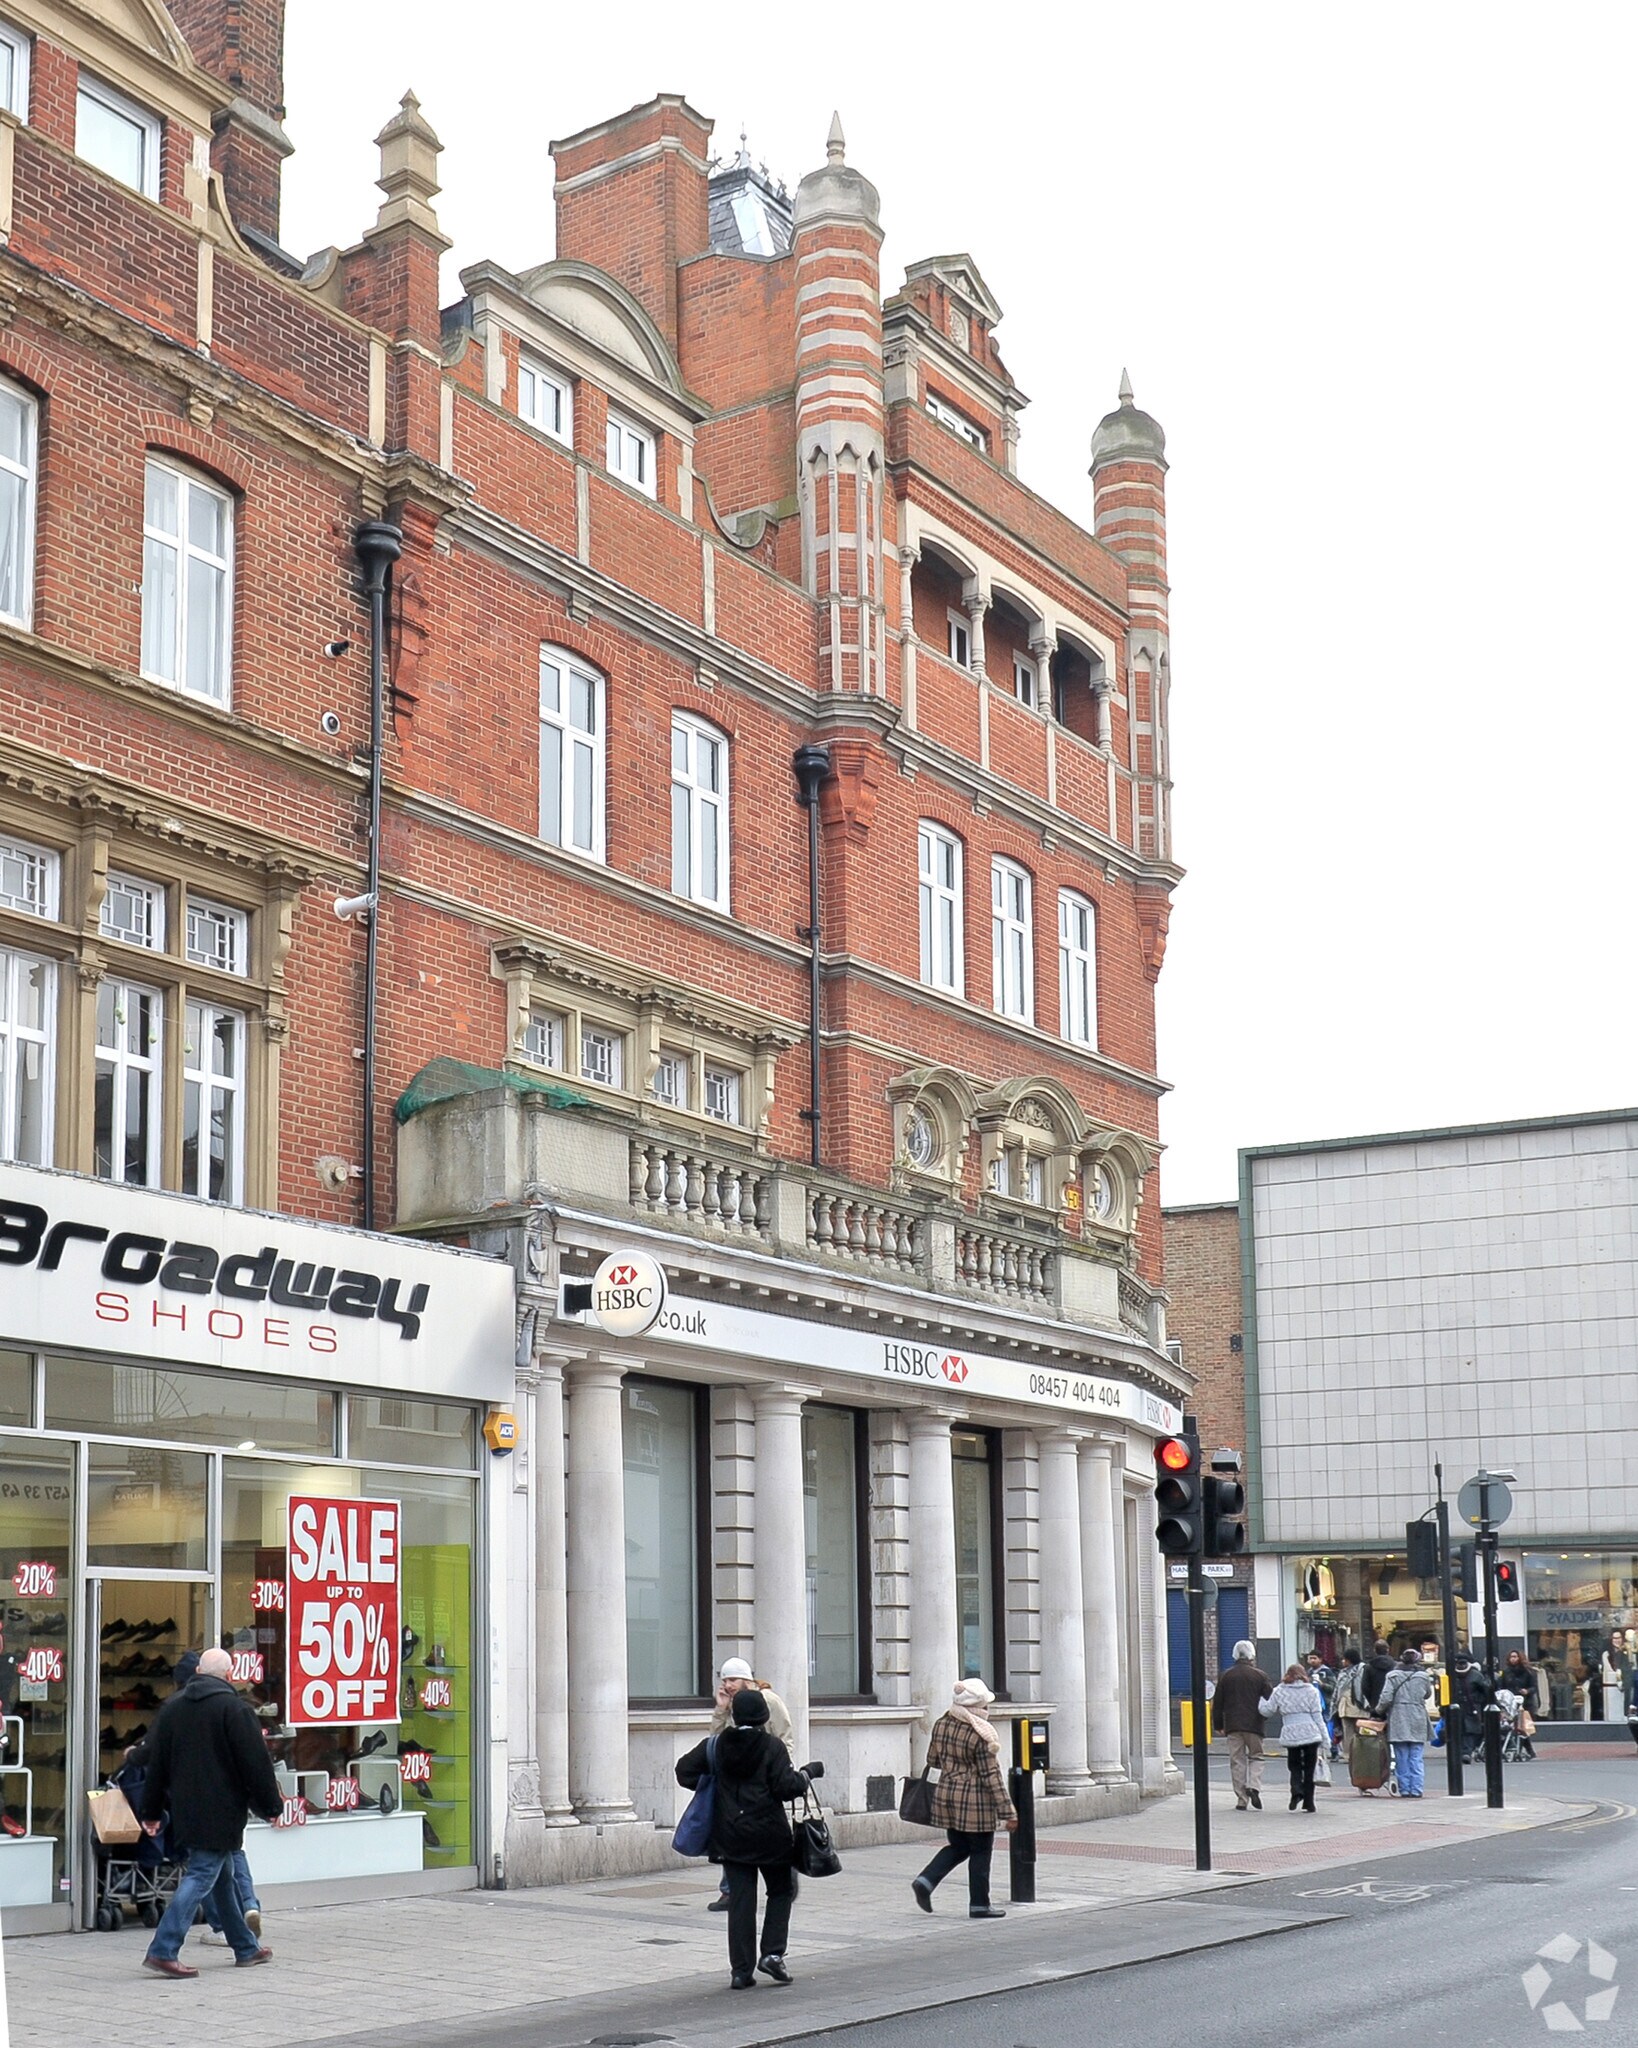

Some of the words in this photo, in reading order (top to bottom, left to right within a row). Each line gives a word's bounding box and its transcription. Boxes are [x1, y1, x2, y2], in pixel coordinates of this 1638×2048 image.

[596, 1287, 653, 1312] HSBC
[95, 1292, 338, 1353] SHOES
[883, 1342, 939, 1379] HSBC
[1029, 1373, 1068, 1399] 08457
[1072, 1381, 1095, 1403] 404
[1098, 1386, 1121, 1408] 404
[290, 1503, 396, 1583] SALE
[15, 1564, 54, 1595] -20%
[251, 1581, 284, 1609] -30%
[326, 1586, 344, 1599] UP
[346, 1586, 363, 1599] TO
[298, 1602, 390, 1677] 50%
[20, 1650, 61, 1681] -40%
[301, 1679, 388, 1719] OFF
[420, 1680, 450, 1707] -40%
[401, 1753, 430, 1780] -20%
[326, 1780, 358, 1807] -30%
